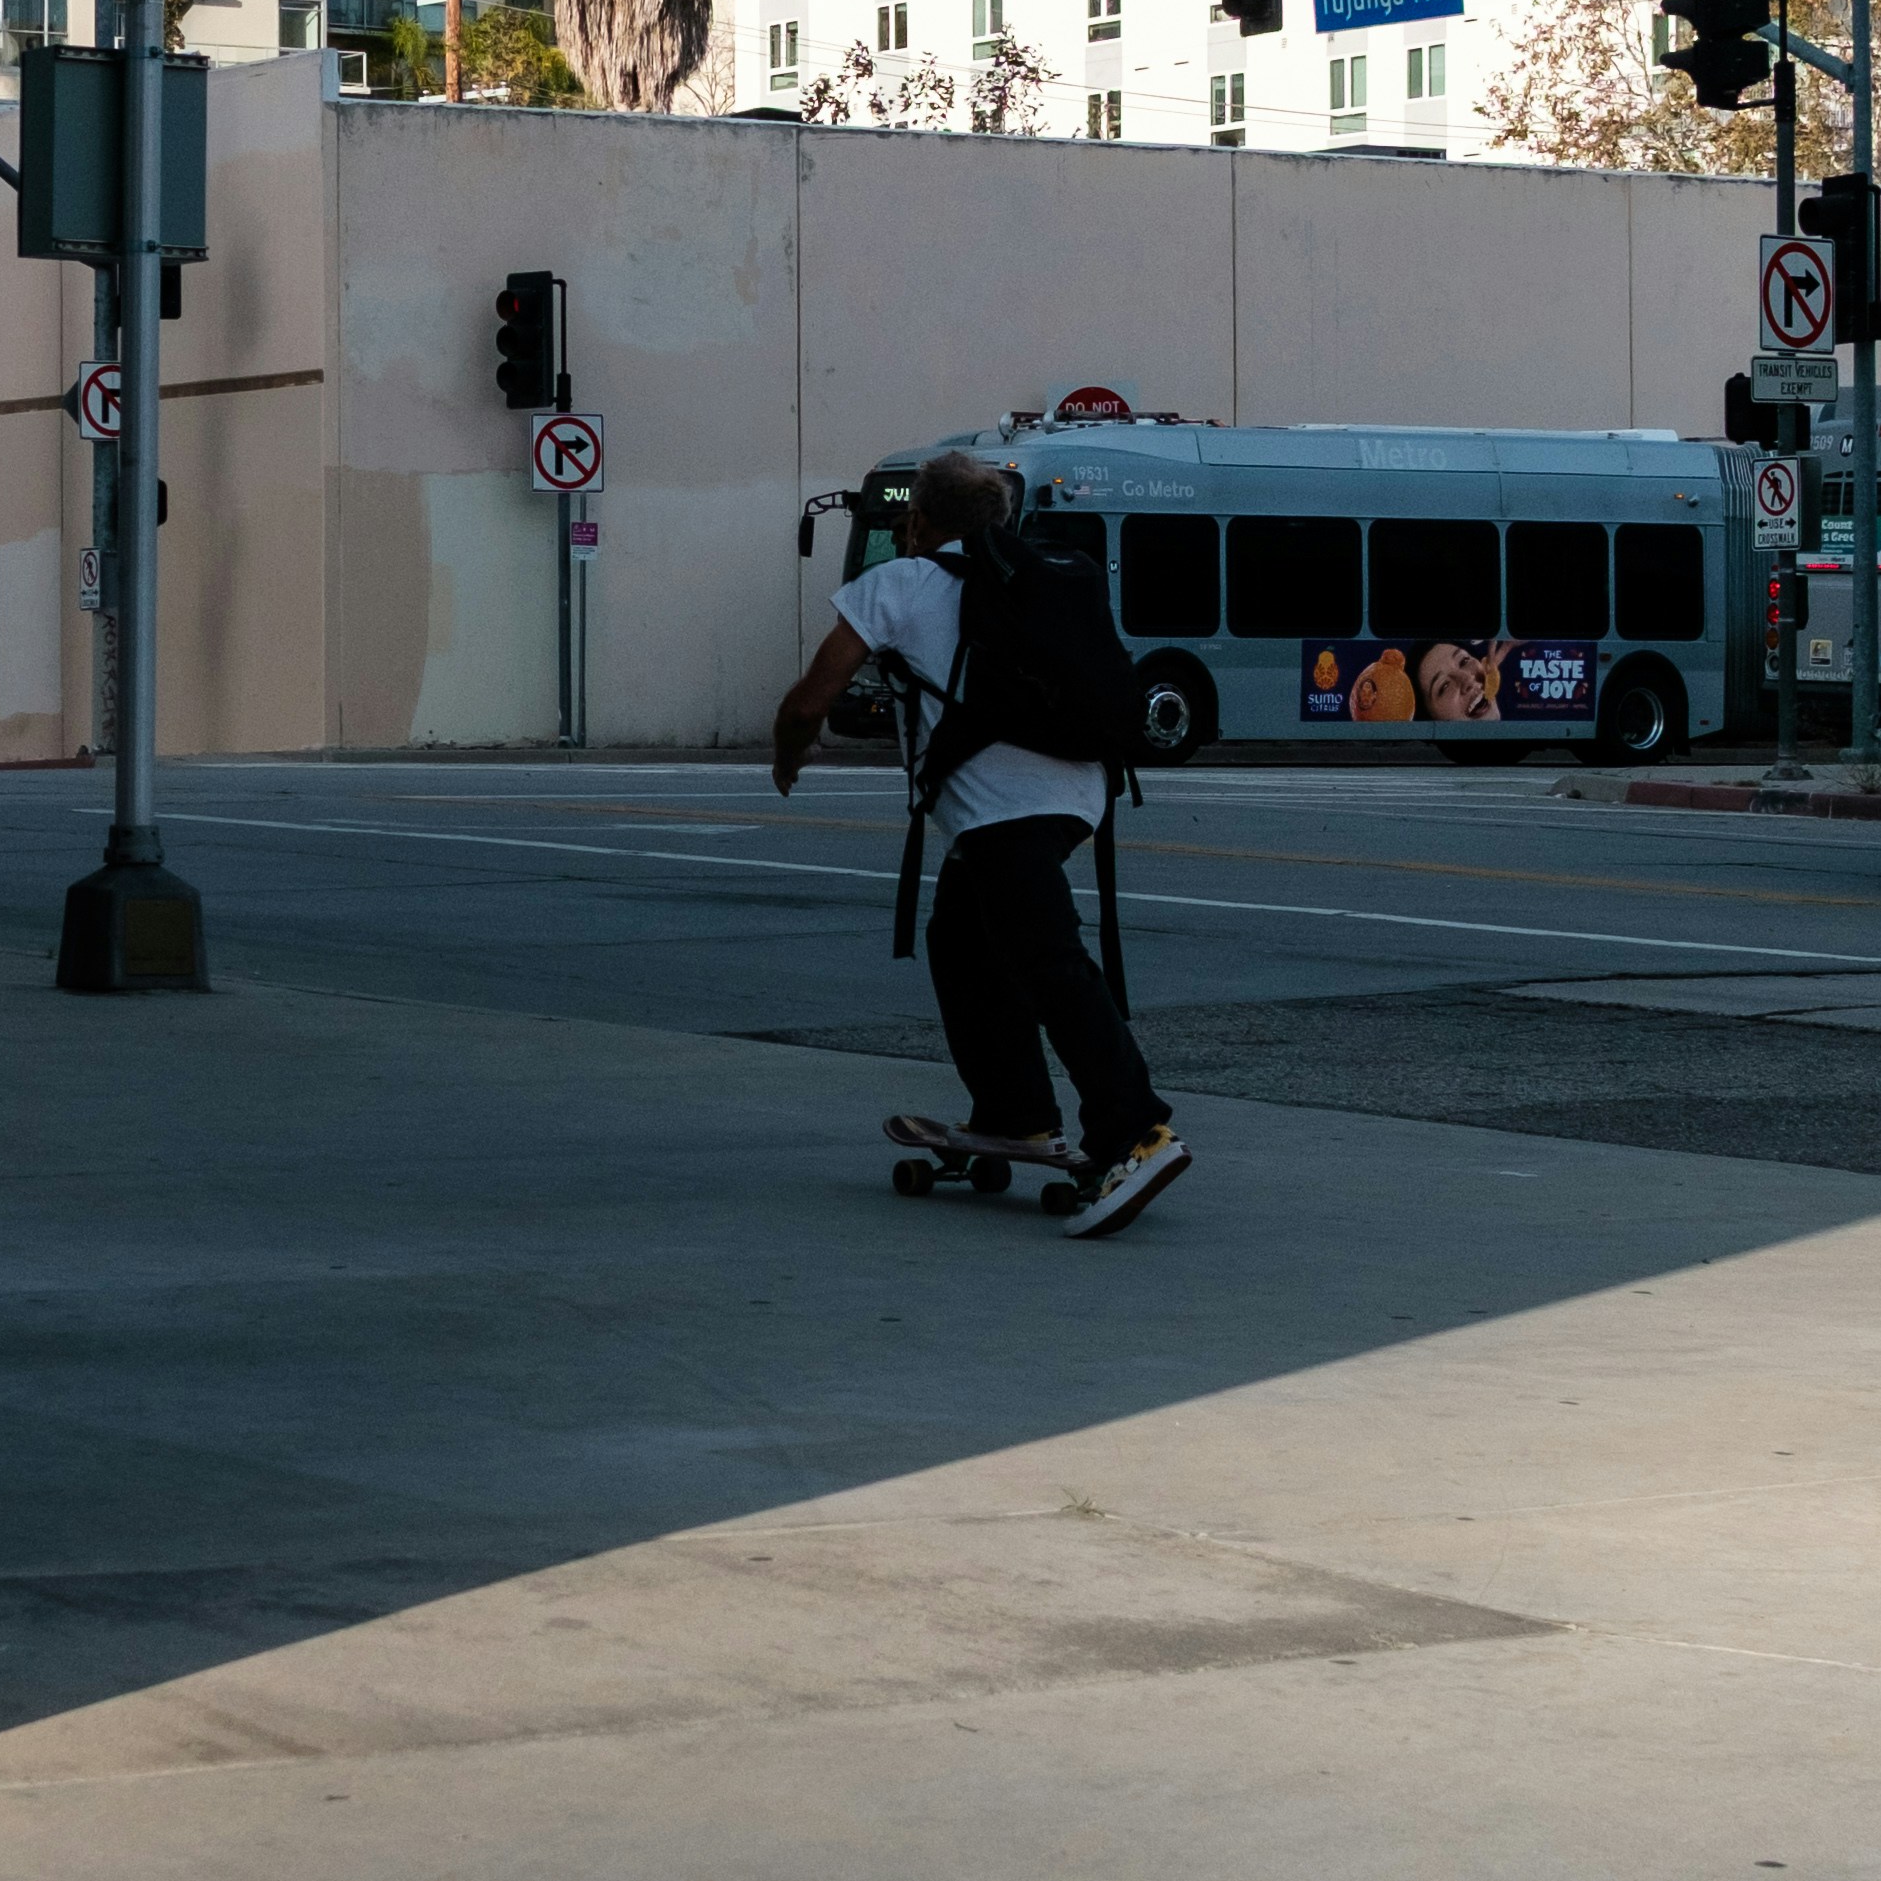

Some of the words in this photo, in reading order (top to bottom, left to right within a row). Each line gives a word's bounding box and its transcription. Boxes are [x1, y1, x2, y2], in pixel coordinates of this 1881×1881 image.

[1759, 364, 1792, 377] TRANSIT
[1795, 363, 1833, 379] VEHICLES
[1780, 382, 1813, 395] EXEMPT
[1065, 402, 1085, 412] DO
[1092, 401, 1120, 413] NOT
[1810, 435, 1834, 451] 509
[1358, 438, 1448, 469] Metro
[1122, 480, 1144, 496] Go
[1149, 480, 1195, 497] Metro
[1768, 518, 1784, 529] USE
[1544, 649, 1562, 659] THE
[1520, 659, 1584, 679] TASTE
[1529, 682, 1541, 692] OF
[1540, 680, 1578, 699] JOY
